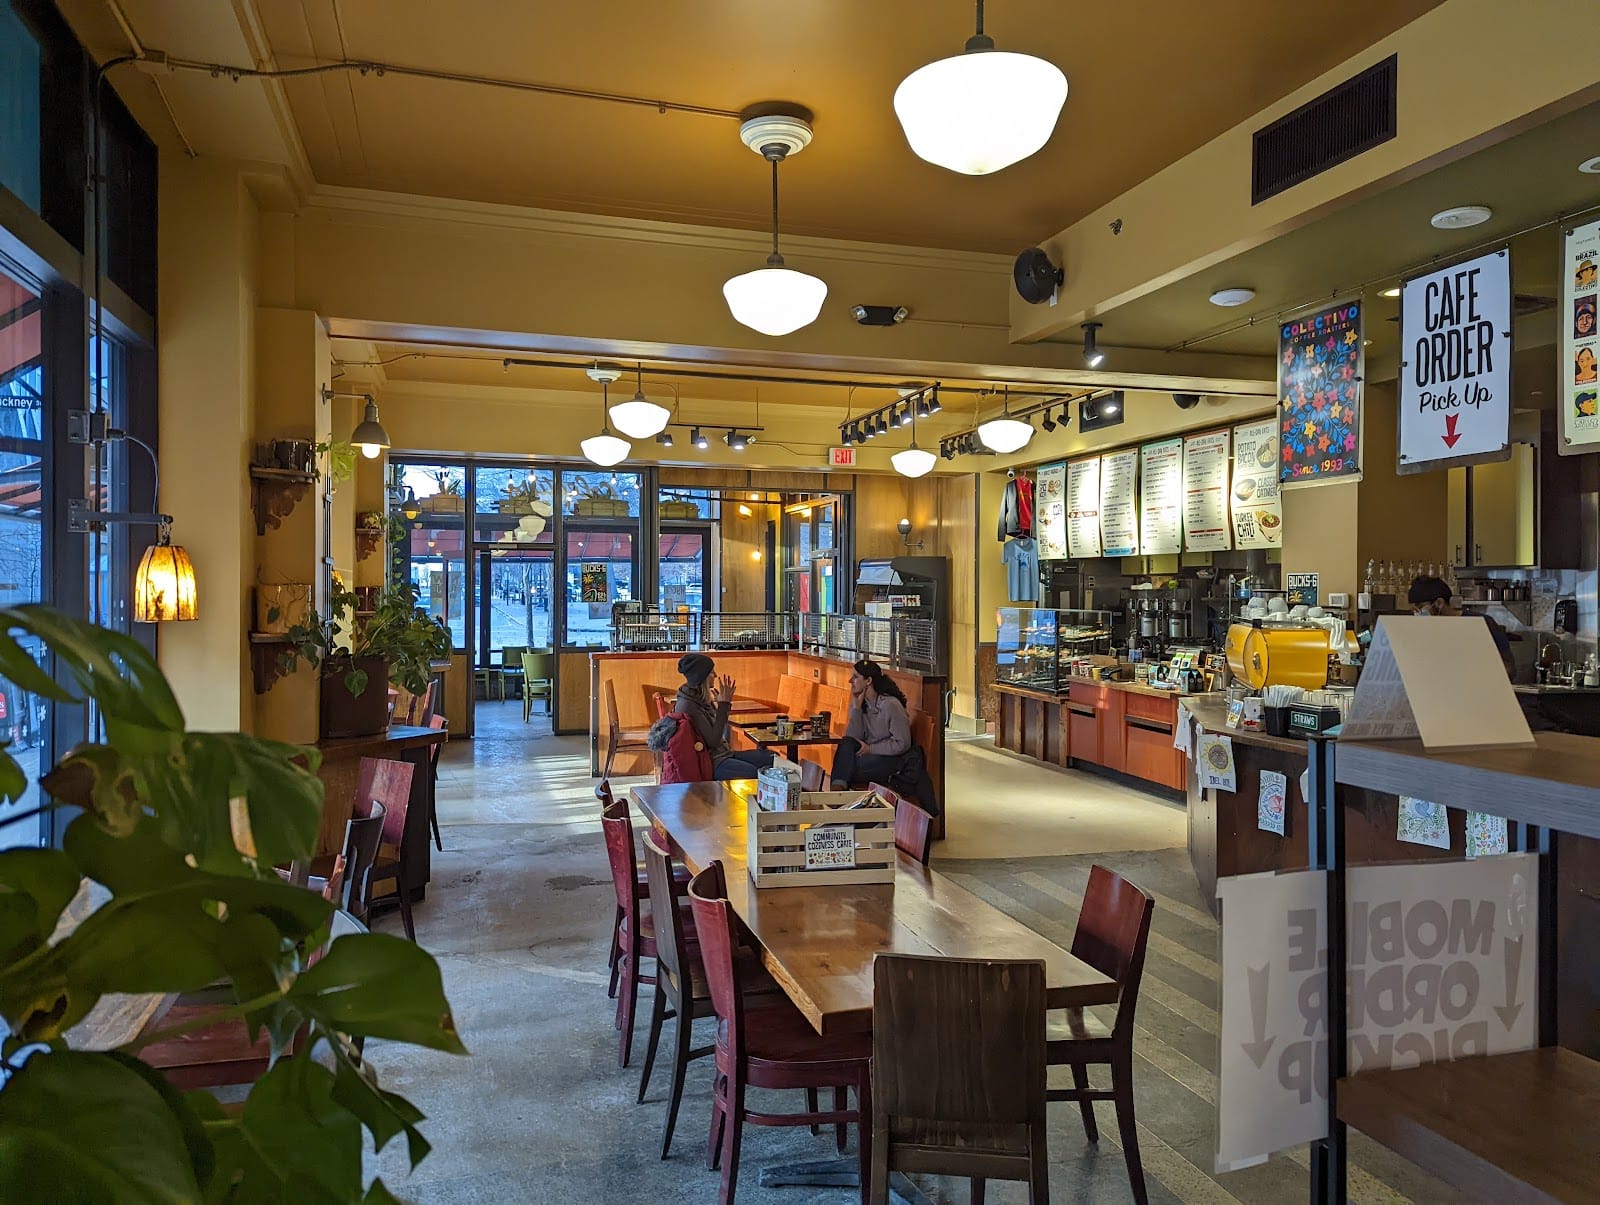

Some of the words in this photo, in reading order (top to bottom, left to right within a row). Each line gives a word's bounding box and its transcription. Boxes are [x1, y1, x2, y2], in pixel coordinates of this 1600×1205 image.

[1575, 249, 1599, 261] BRAZIL
[1425, 267, 1481, 333] CAFE
[1283, 306, 1358, 339] COLECTIVO
[1416, 320, 1494, 388] ORDER
[0, 396, 33, 409] ckney
[1419, 385, 1461, 414] Pick
[1464, 381, 1493, 411] Up
[1237, 441, 1256, 454] POTATO
[835, 449, 853, 464] EXIT
[1292, 463, 1319, 477] Since
[1321, 459, 1343, 472] 1993
[1288, 575, 1317, 587] BUCKS-6
[1294, 714, 1315, 727] STRAWS
[813, 832, 846, 841] COMMUNITY
[808, 841, 834, 850] COZINESS
